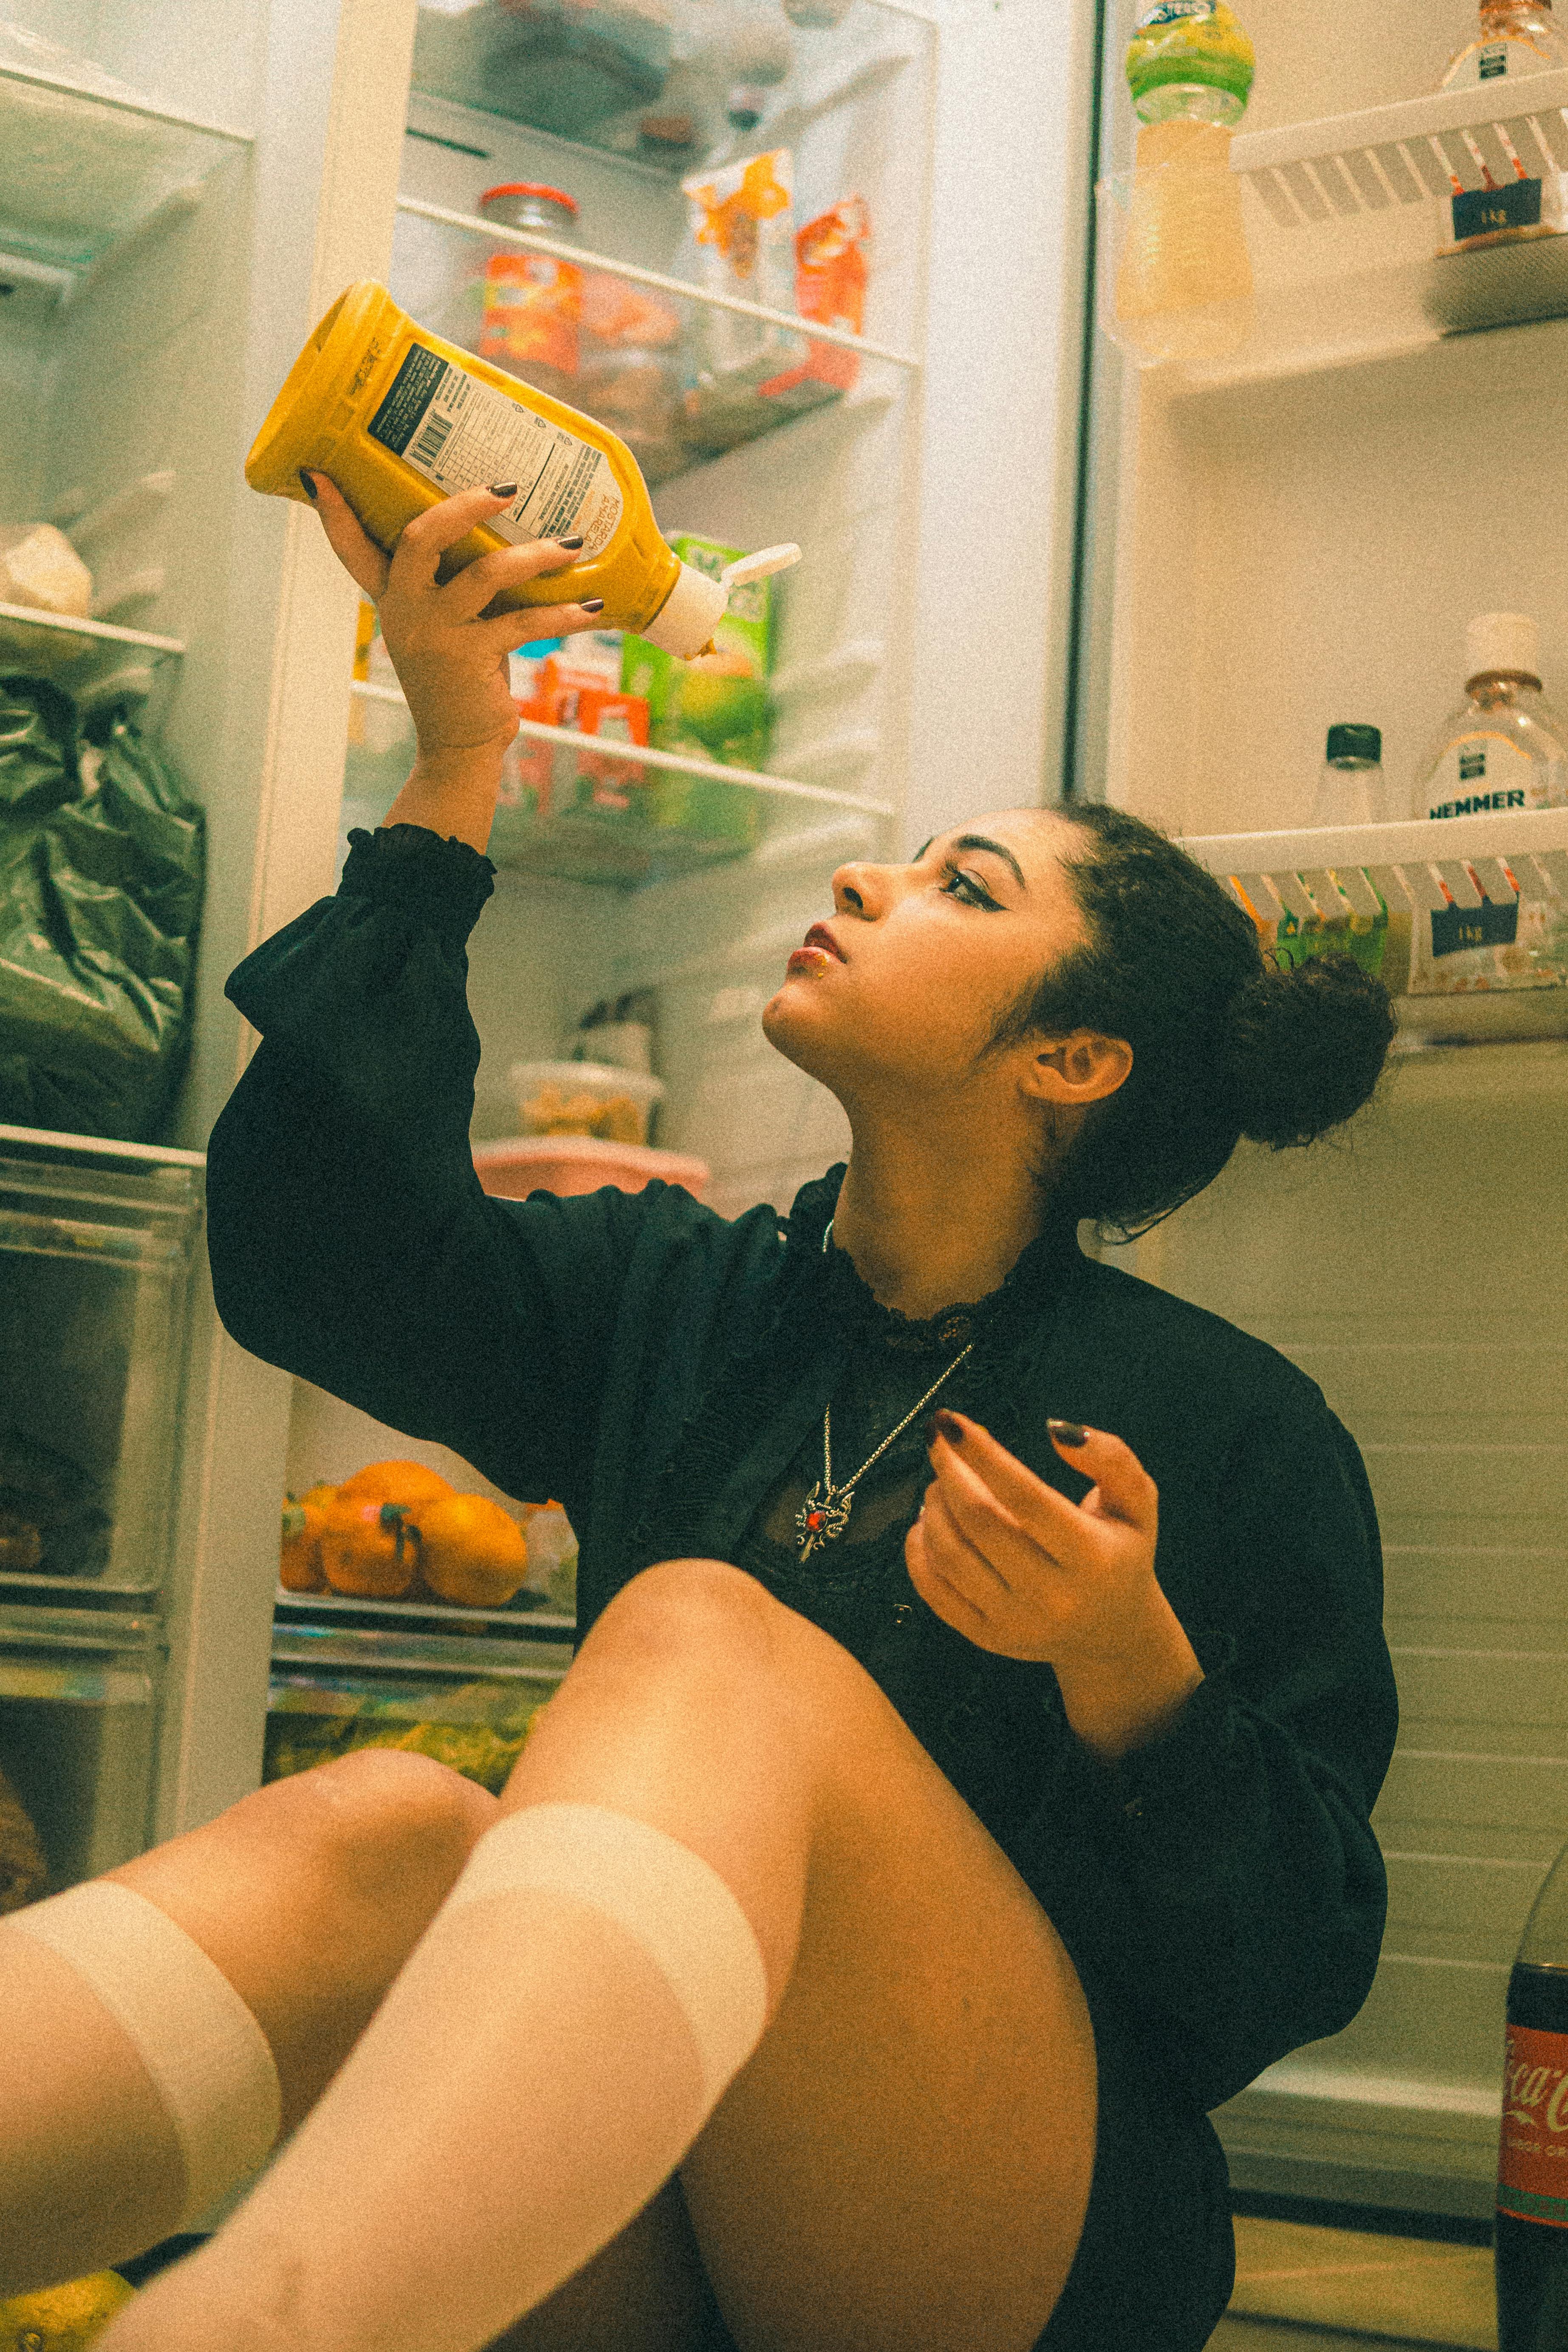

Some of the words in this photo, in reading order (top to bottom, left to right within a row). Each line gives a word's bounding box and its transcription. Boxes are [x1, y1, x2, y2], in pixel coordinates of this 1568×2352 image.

[583, 494, 610, 541] AMARELA
[588, 497, 620, 551] MOSTARDA
[1430, 789, 1525, 820] HEMMER
